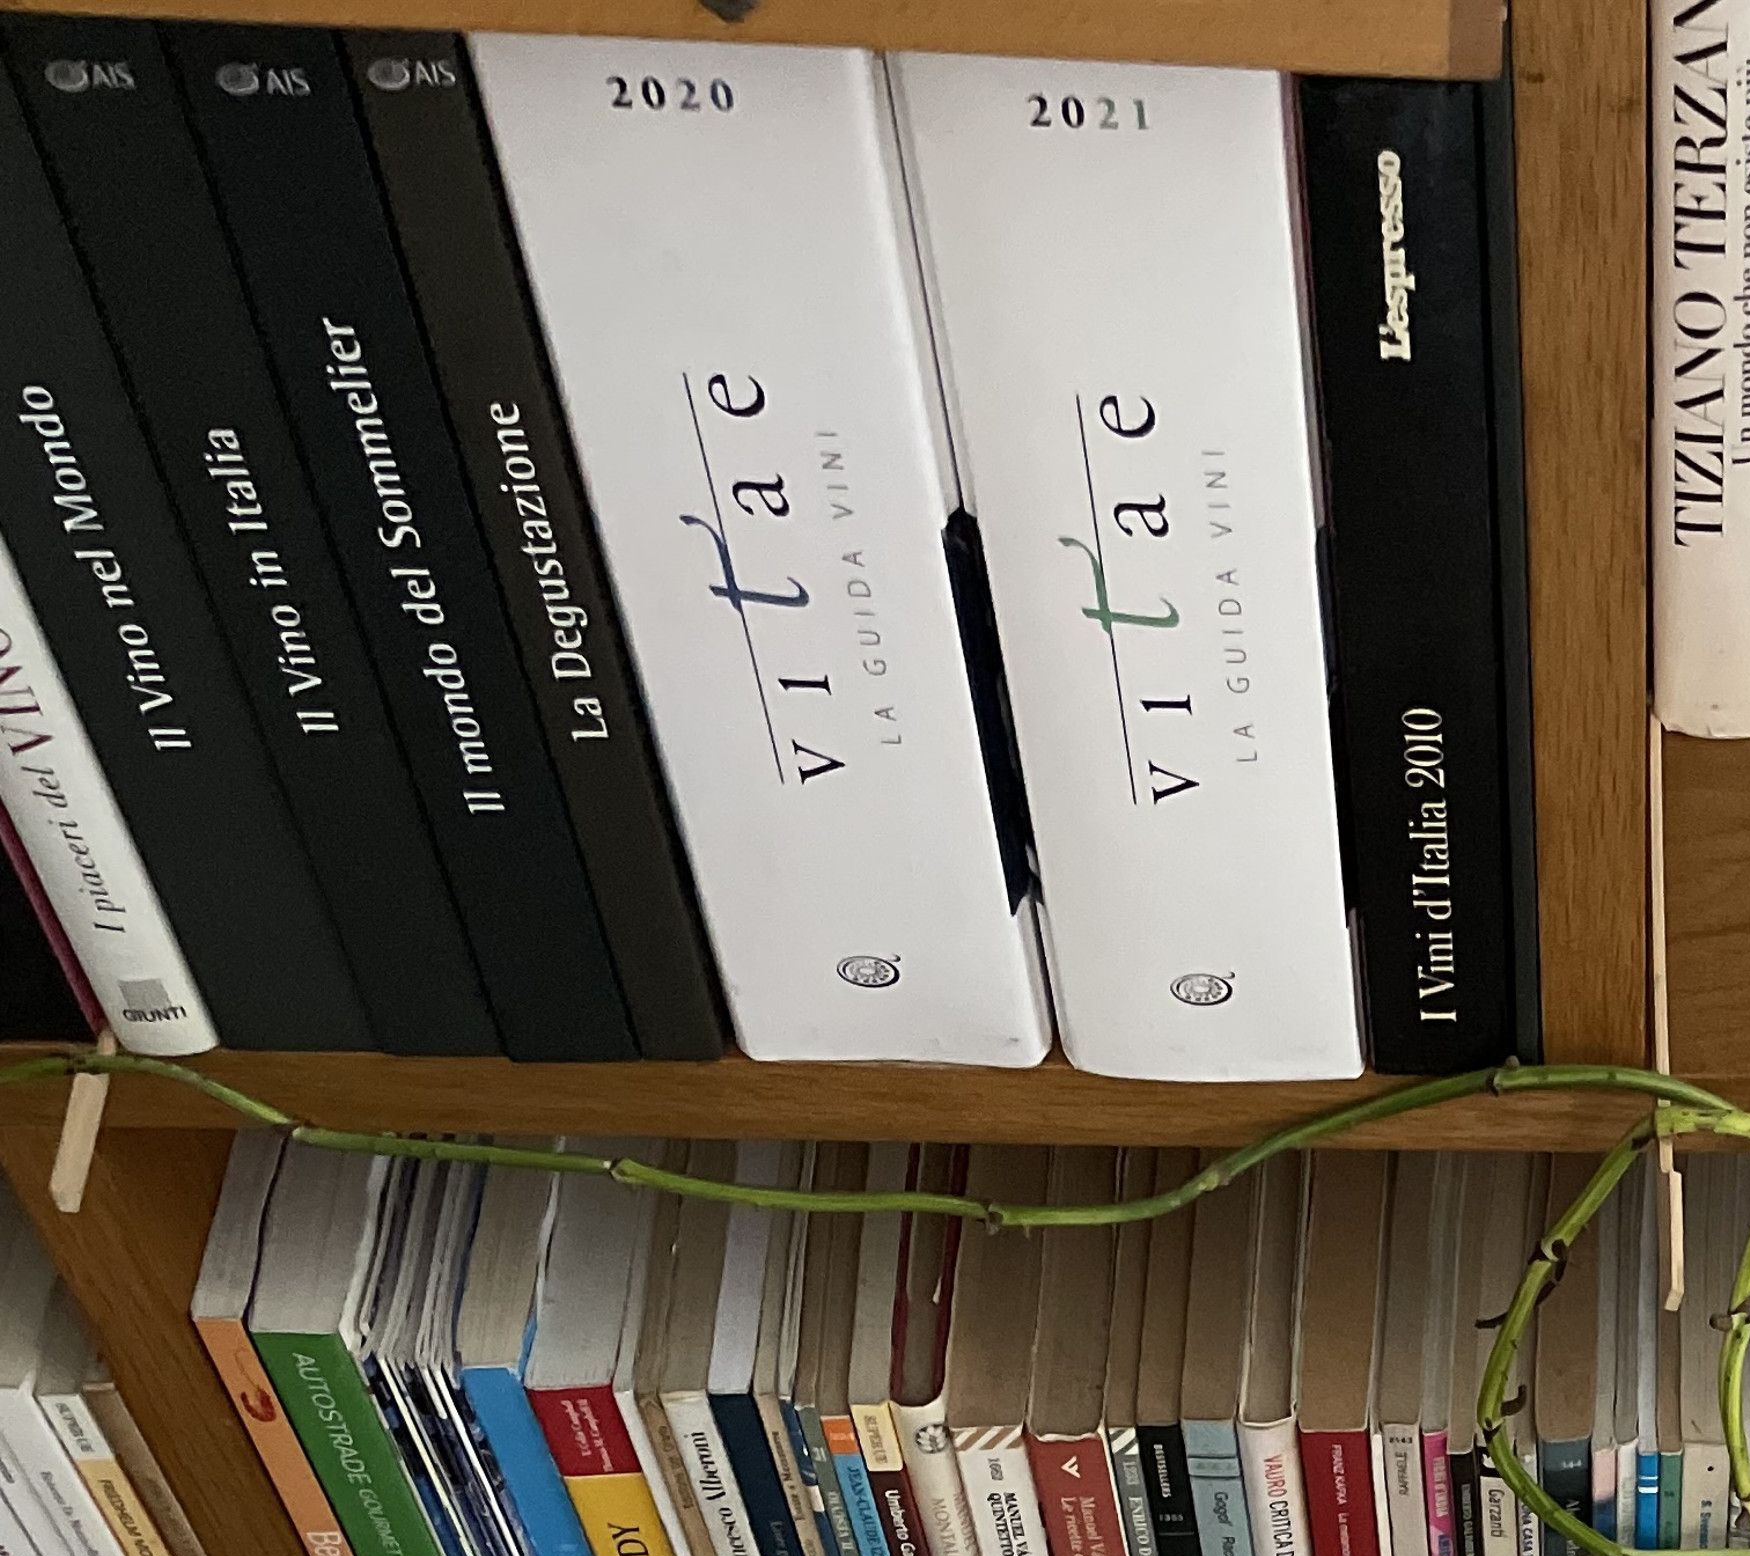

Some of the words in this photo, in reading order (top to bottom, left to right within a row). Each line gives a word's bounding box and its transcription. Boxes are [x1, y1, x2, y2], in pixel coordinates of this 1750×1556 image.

[92, 58, 136, 91] AIS
[268, 65, 311, 96] AIS
[413, 60, 456, 89] AIS
[607, 76, 735, 113] 2020
[1028, 95, 1150, 131] 2021
[1377, 150, 1412, 361] L'espresso
[322, 318, 421, 552] Sommelier
[1674, 290, 1729, 547] TIZIANO
[19, 385, 110, 534] Mondo
[206, 427, 268, 537] Italia
[816, 430, 853, 520] VINI
[1201, 447, 1234, 540] VINI
[251, 550, 284, 593] in
[490, 402, 599, 683] Degustazione
[82, 548, 135, 608] nel
[402, 567, 447, 630] del
[843, 550, 886, 677] GUIDA
[1217, 567, 1249, 696] GUIDA
[118, 624, 174, 714] Vino
[273, 606, 330, 694] Vino
[147, 727, 192, 751] Il
[304, 711, 338, 737] Il
[421, 644, 491, 777] mondo
[571, 700, 607, 741] La
[875, 706, 902, 746] LA
[1234, 722, 1256, 763] LA
[1403, 706, 1448, 786] 2010
[21, 765, 67, 808] del
[465, 789, 504, 814] Il
[48, 820, 126, 914] piaceri
[1408, 795, 1452, 919] d'Italia
[1414, 930, 1457, 1001] Vini
[122, 1006, 187, 1023] GIUNTI
[1420, 1009, 1457, 1022] I
[293, 1352, 371, 1484] AUTOSTRADE
[1263, 1454, 1285, 1497] VAURO
[1270, 1500, 1293, 1549] CRITICA
